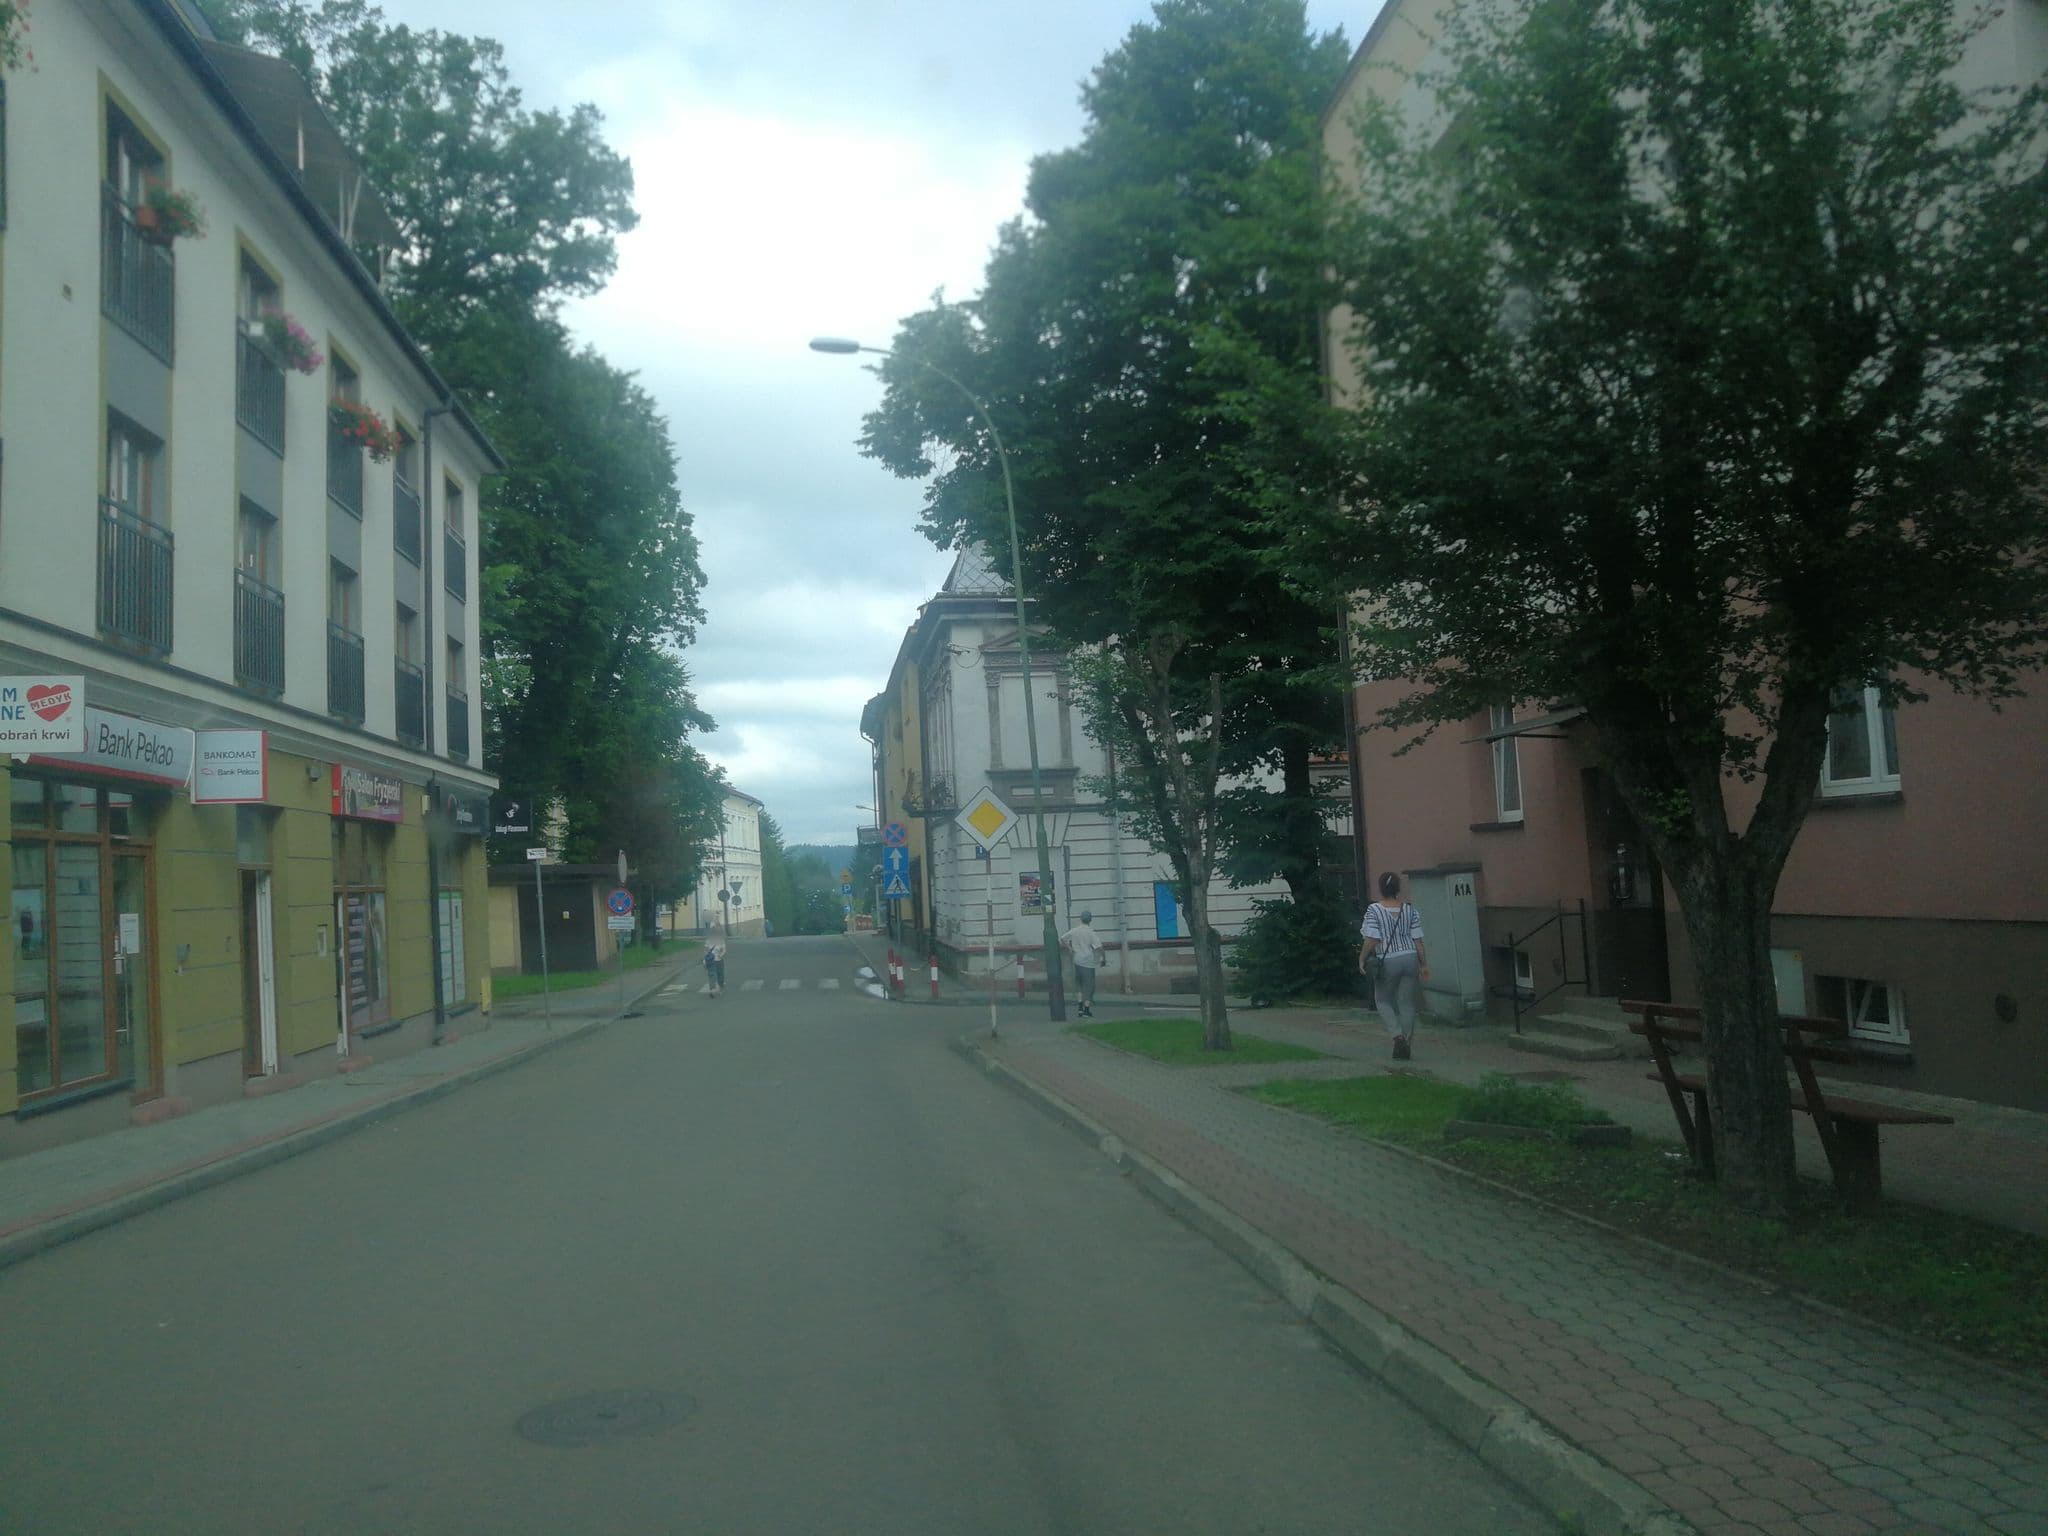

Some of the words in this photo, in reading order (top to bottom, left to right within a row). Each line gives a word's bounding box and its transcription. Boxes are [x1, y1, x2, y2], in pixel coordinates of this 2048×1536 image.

[31, 692, 72, 711] MEDYK
[41, 729, 71, 740] krwi
[98, 723, 134, 759] Bank
[135, 731, 174, 766] Pekao
[204, 751, 256, 759] BANKOMAT
[217, 768, 234, 776] Bank
[236, 768, 260, 776] Pekao
[1455, 884, 1472, 896] A1A
